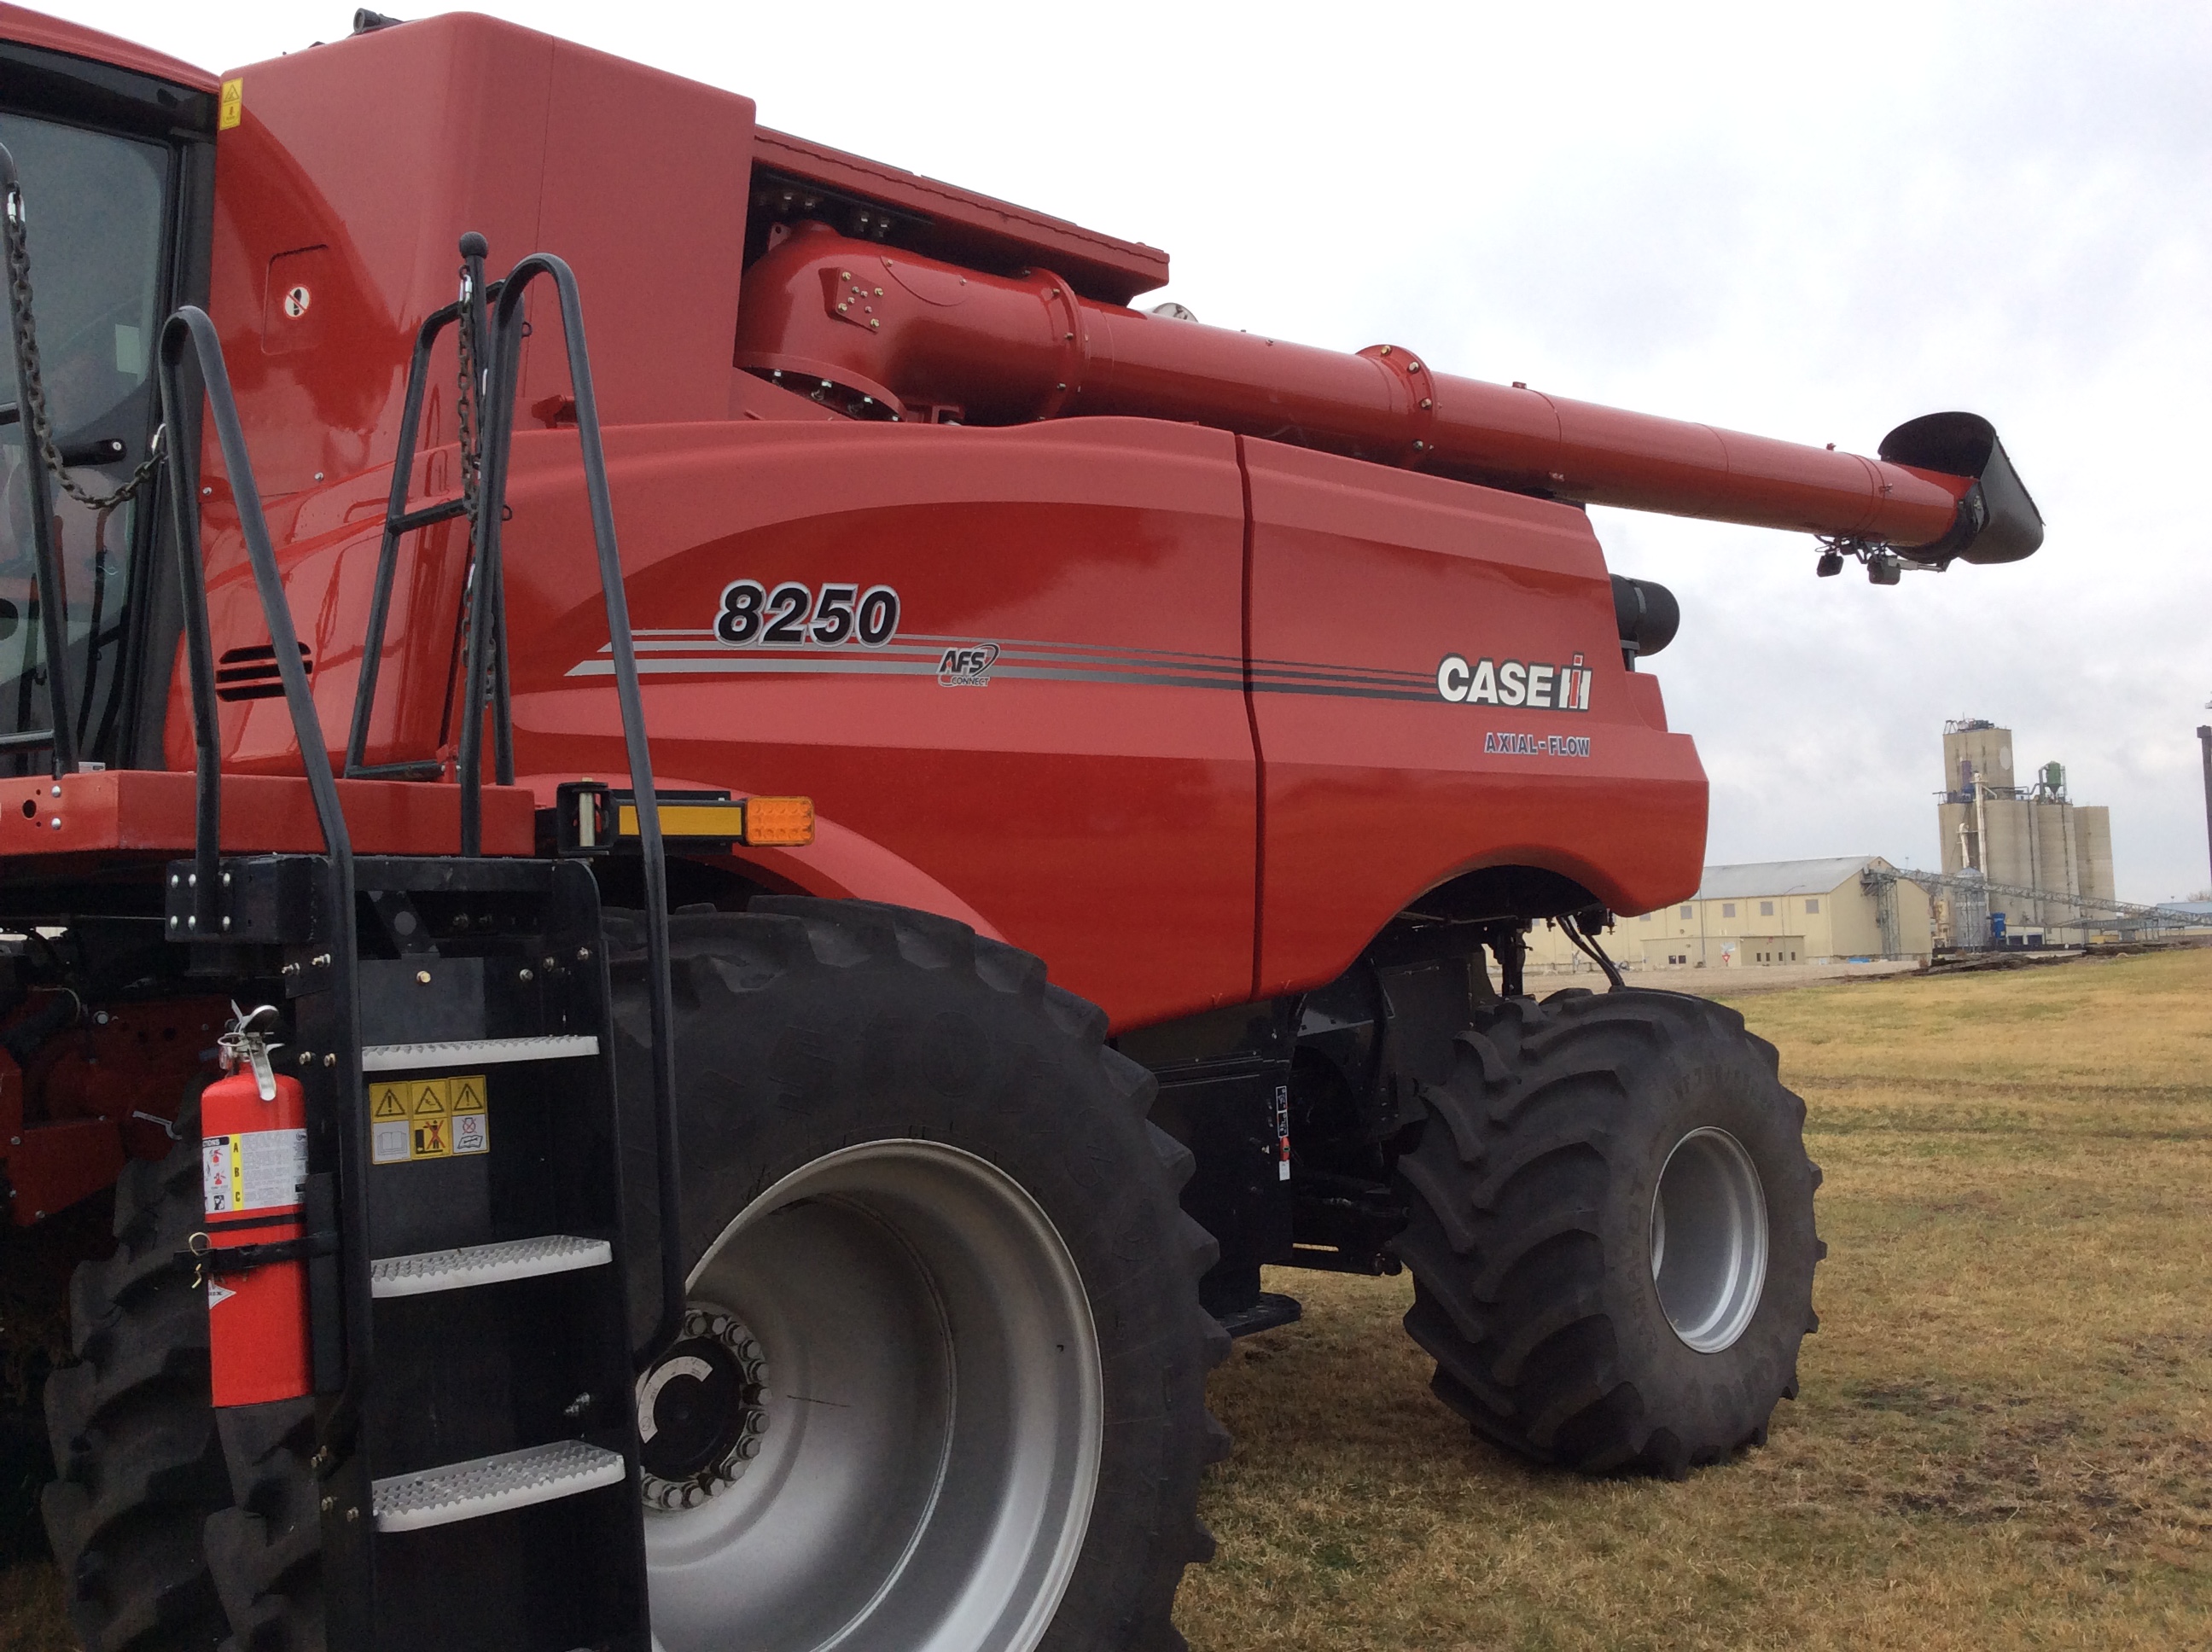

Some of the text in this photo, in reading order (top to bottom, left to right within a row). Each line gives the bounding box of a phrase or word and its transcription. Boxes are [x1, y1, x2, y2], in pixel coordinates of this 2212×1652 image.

[713, 579, 900, 648] 8250
[939, 649, 986, 673] AFS
[952, 677, 989, 686] CONNECT
[1438, 656, 1554, 707] CASE
[1484, 732, 1590, 757] AXIAL-FLOW
[233, 1143, 239, 1153] A
[234, 1166, 240, 1178] B
[235, 1191, 241, 1202] C
